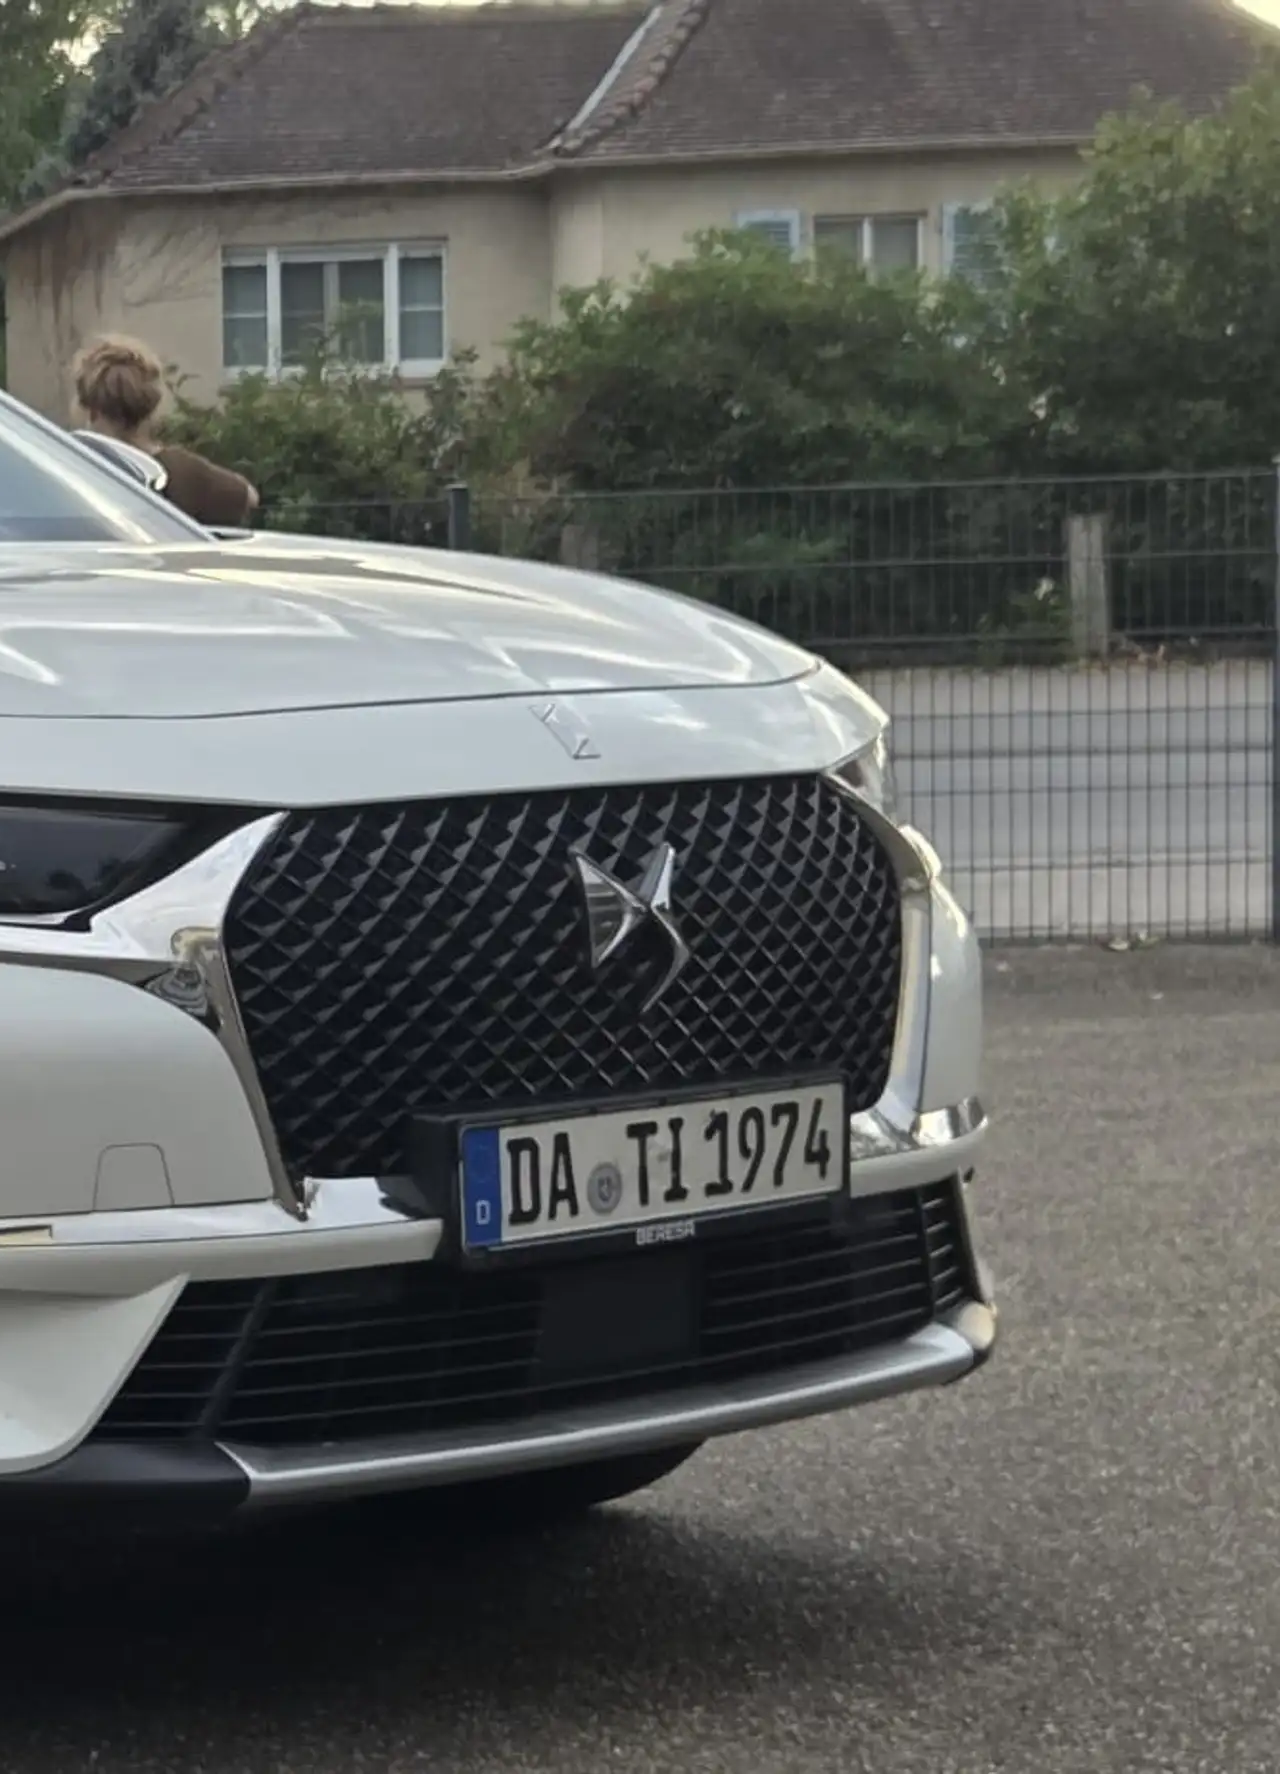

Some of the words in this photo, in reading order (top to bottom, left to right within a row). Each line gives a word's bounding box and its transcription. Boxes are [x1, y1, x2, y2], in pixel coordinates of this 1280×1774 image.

[507, 1132, 579, 1226] DA
[626, 1117, 688, 1206] TI
[704, 1098, 831, 1197] 1974
[476, 1200, 491, 1225] D
